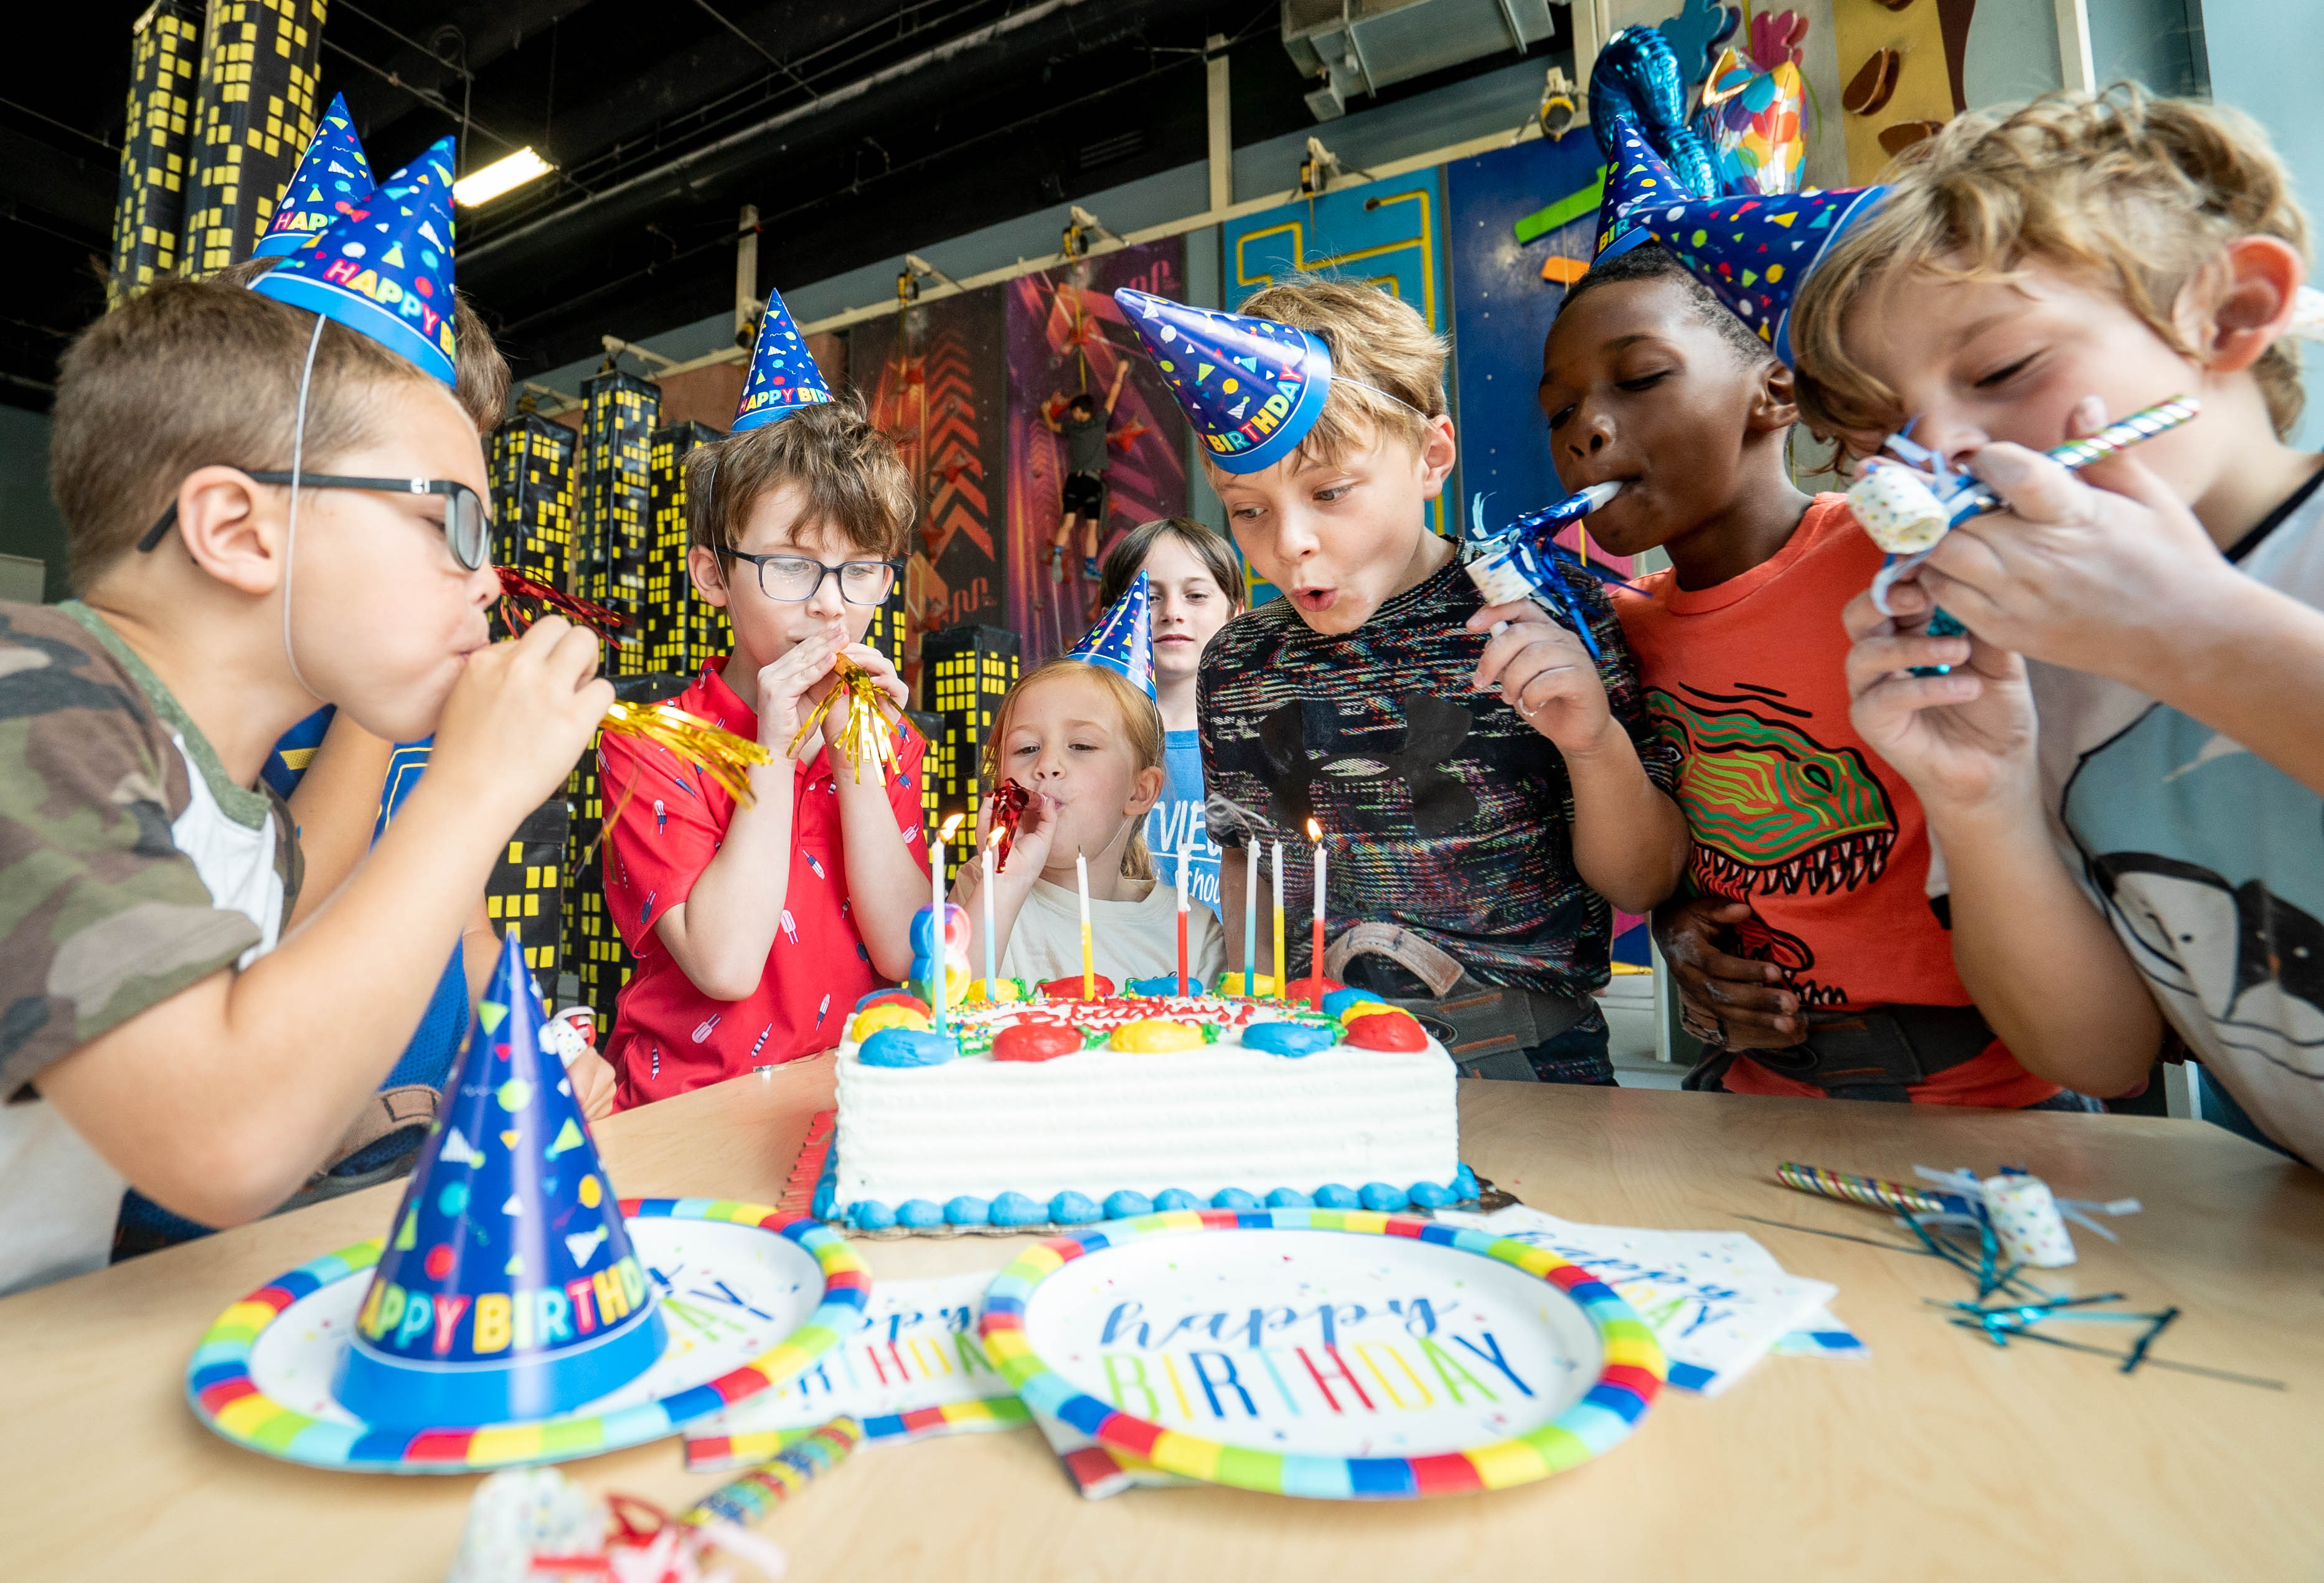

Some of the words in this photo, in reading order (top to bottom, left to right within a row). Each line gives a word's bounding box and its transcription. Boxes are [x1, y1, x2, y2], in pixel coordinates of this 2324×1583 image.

[323, 258, 440, 336] HAPPY
[738, 387, 795, 415] HAPPY
[797, 387, 836, 404] BIRT
[1206, 362, 1302, 452] BIRTHDAY
[1099, 1298, 1459, 1350] happy
[1101, 1331, 1537, 1420] BIRTHDAY
